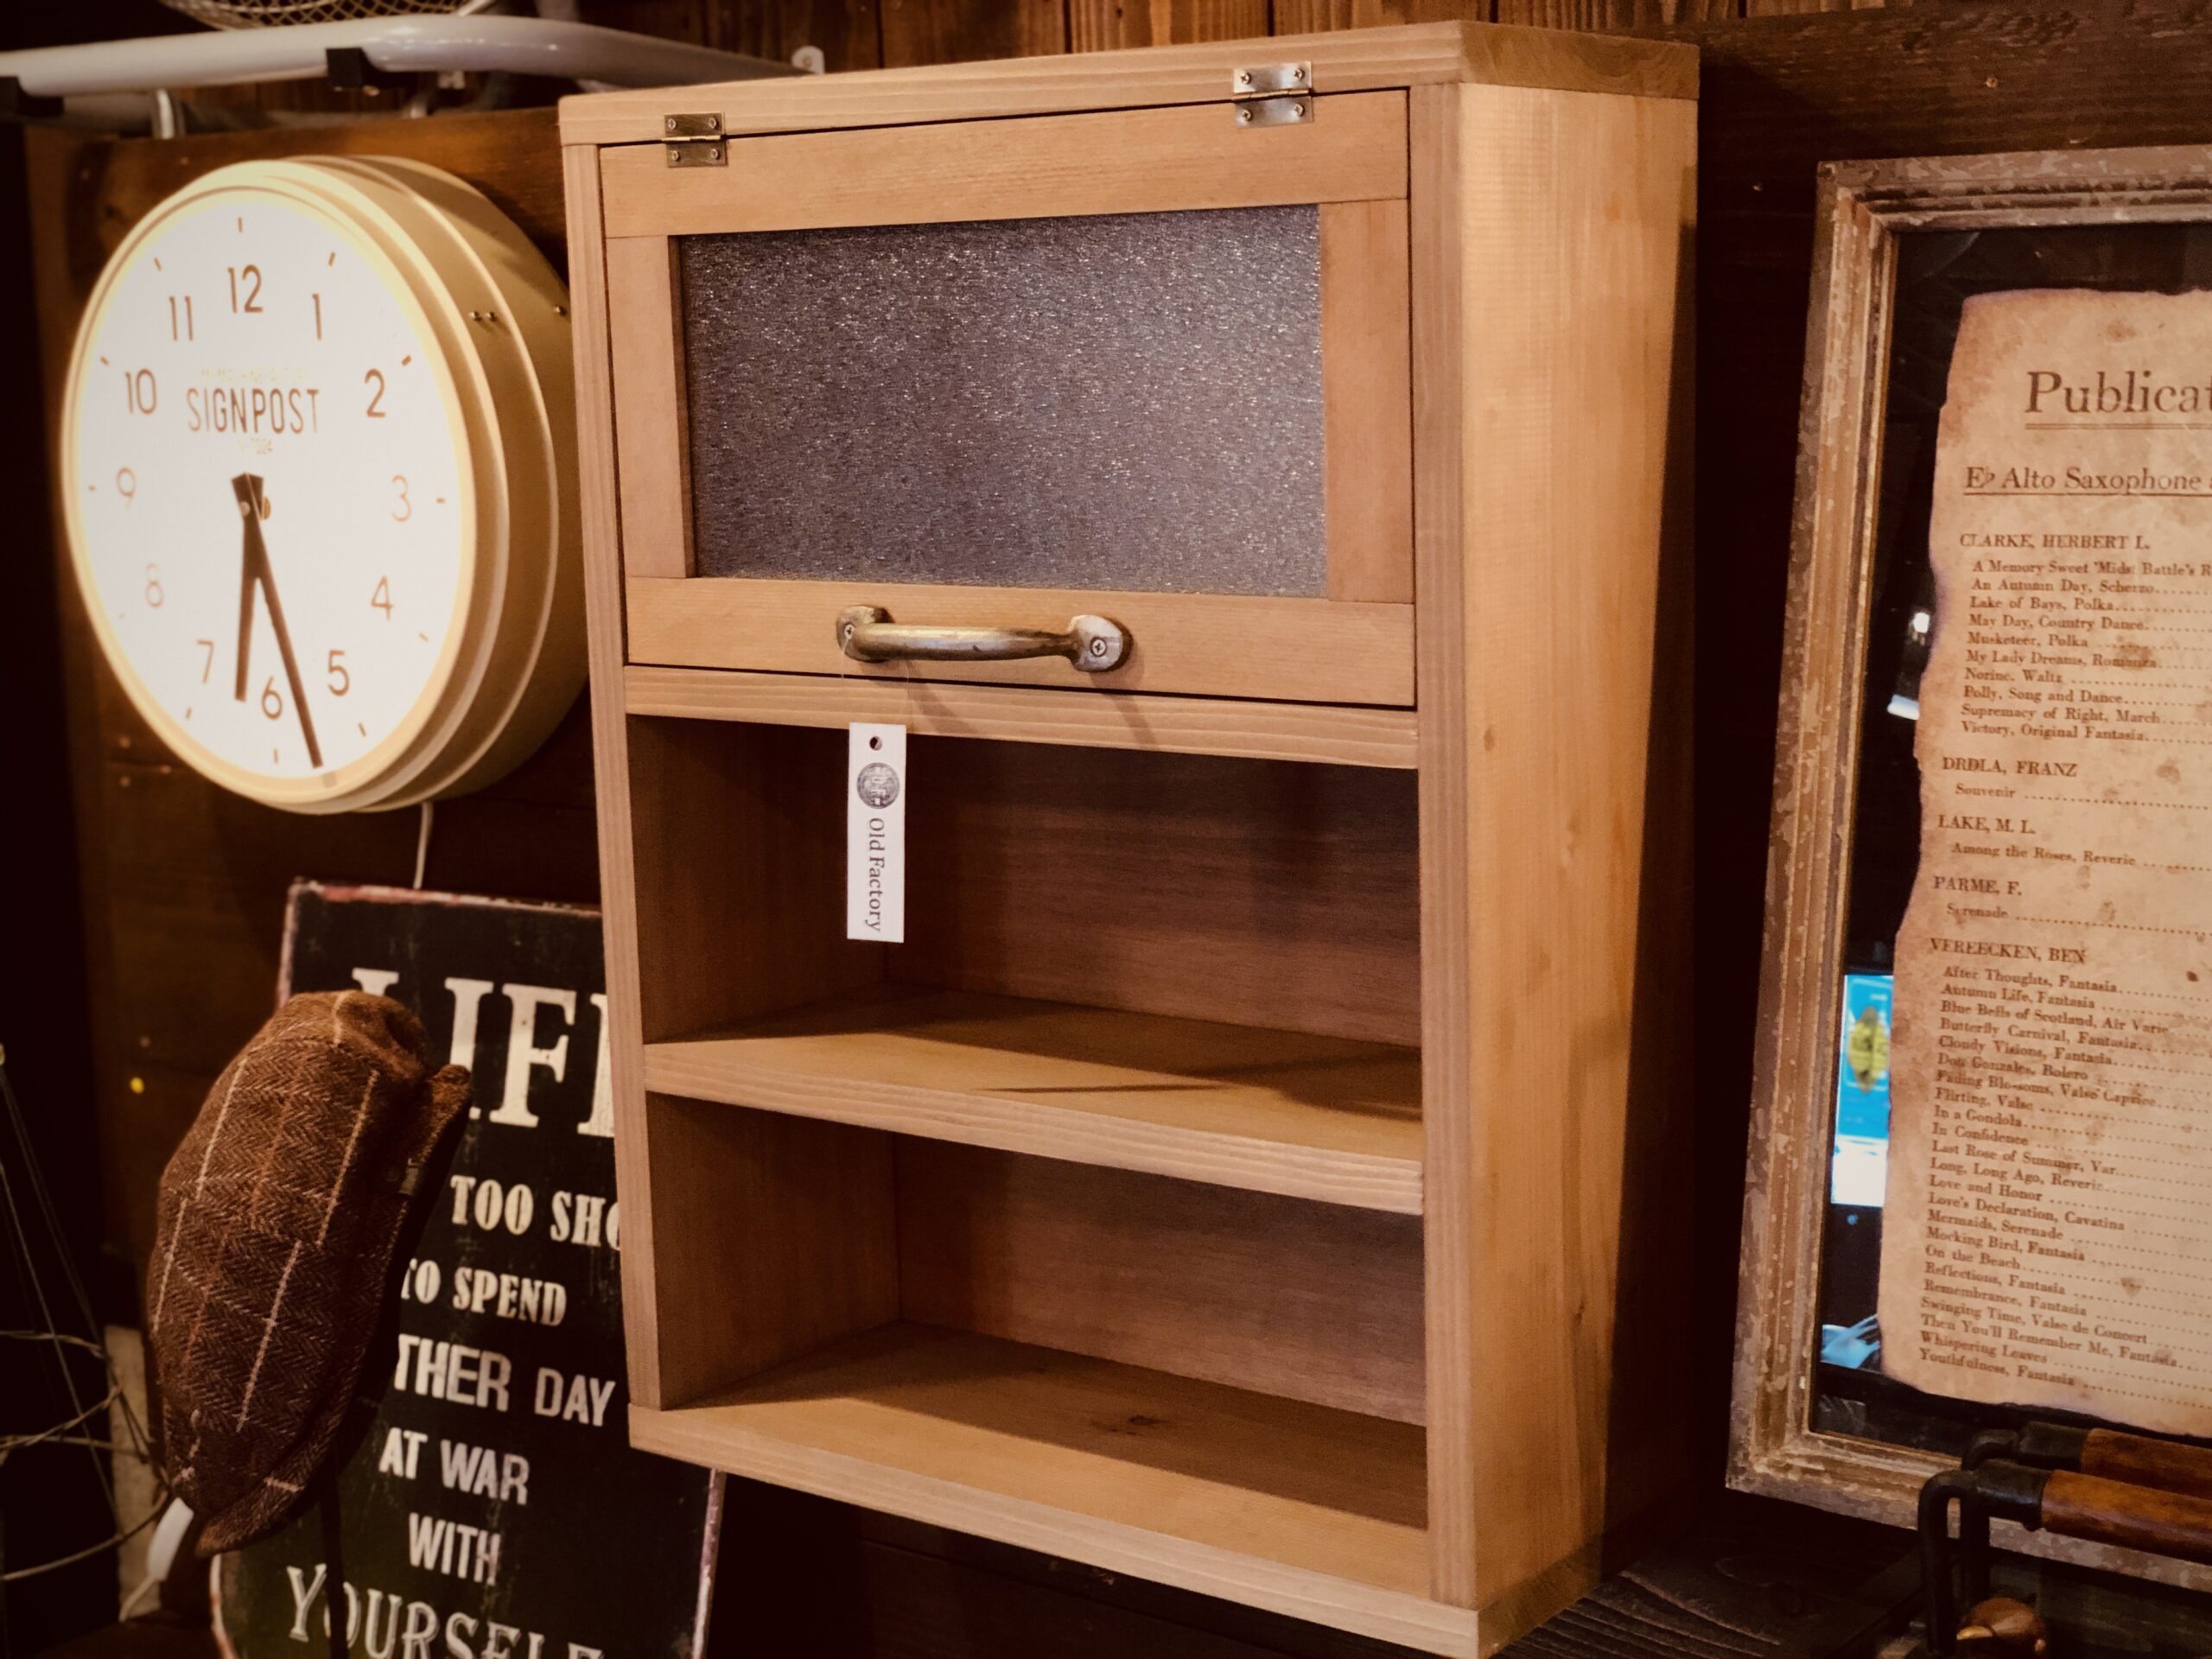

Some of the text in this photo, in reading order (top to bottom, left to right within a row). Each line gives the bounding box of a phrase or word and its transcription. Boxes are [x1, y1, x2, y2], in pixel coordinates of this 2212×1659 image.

[228, 264, 264, 313] 12
[169, 296, 194, 340] 11
[312, 294, 321, 339] 1
[125, 370, 157, 414] 10
[365, 370, 386, 416] 2
[187, 388, 319, 434] SIGNPOST
[117, 467, 137, 510] 9
[2002, 466, 2055, 489] Alto
[2065, 467, 2201, 493] Saxophone
[391, 475, 411, 521] 3
[2042, 534, 2129, 549] HERBERT
[2136, 535, 2150, 550] L.
[1973, 560, 2195, 576] A Memory Sweet Battle's
[146, 563, 163, 607] 8
[371, 575, 393, 620] 4
[1972, 579, 1990, 590] An
[1999, 580, 2053, 591] Autumn
[1971, 596, 2002, 608] Lake
[2009, 597, 2024, 608] of
[2075, 598, 2113, 611] Polka
[1969, 613, 1996, 629] May
[2039, 616, 2094, 631] Country
[2101, 617, 2144, 630] Dance
[2050, 633, 2088, 647] Polka
[197, 640, 214, 683] 7
[1967, 650, 1986, 664] My
[1993, 650, 2024, 665] Lady
[327, 650, 350, 696] 5
[2023, 669, 2062, 683] Waltz
[261, 676, 282, 719] 6
[2009, 688, 2042, 703] Song
[2049, 690, 2073, 702] and
[2081, 690, 2122, 703] Dance
[1961, 703, 2035, 720] Supremacy
[2044, 707, 2057, 720] of
[2117, 709, 2159, 723] March
[2022, 721, 2076, 739] Original
[2085, 726, 2143, 741] Fantasia
[2017, 760, 2076, 777] FRANZ
[1955, 784, 2015, 798] Souvenir
[869, 817, 885, 850] Old
[2022, 820, 2036, 835] L.
[1952, 842, 1999, 857] Among
[2005, 845, 2027, 857] the
[2083, 850, 2136, 865] Reverie
[865, 856, 885, 931] Factory
[2008, 880, 2022, 895] F.
[2050, 946, 2087, 963] BEN
[1943, 966, 1979, 980] After
[2060, 974, 2117, 992] Fantasia
[1942, 983, 1996, 999] Autumn
[2037, 990, 2094, 1008] Fantasia
[2016, 1007, 2029, 1020] of
[2102, 1016, 2126, 1030] Air
[1940, 1017, 1998, 1036] Butterfly
[2077, 1031, 2139, 1050] Fantasia
[1939, 1035, 1986, 1052] Cloudy
[2055, 1046, 2112, 1065] Fantasia
[2043, 1063, 2088, 1079] Bolero
[1932, 1122, 1947, 1135] In
[1935, 1105, 1948, 1118] In
[1967, 1109, 2022, 1127] Gondola
[1932, 1140, 1959, 1155] Last
[1965, 1143, 1998, 1160] Rose
[2003, 1149, 2018, 1161] of
[1929, 1174, 2043, 1201] Love and Honor
[1974, 1163, 2007, 1180] Long
[2051, 1173, 2105, 1190] Reverie
[450, 1175, 534, 1235] TOO
[1929, 1192, 1969, 1209] Love's
[2064, 1211, 2125, 1230] Cavatina
[1926, 1226, 1983, 1249] Mocking
[2028, 1241, 2085, 1261] Fantasia
[2002, 1220, 2063, 1240] Serenade
[1926, 1243, 1945, 1257] On
[1953, 1249, 1974, 1262] the
[453, 1267, 567, 1326] SPEND
[2009, 1274, 2065, 1294] Fantasia
[2030, 1296, 2087, 1315] Fantasia
[1921, 1297, 1981, 1319] Swinging
[2073, 1320, 2089, 1334] de
[2094, 1325, 2147, 1344] Concert
[1921, 1330, 1997, 1357] Whispering
[1922, 1313, 1955, 1331] Then
[2008, 1327, 2082, 1351] Remember
[2120, 1345, 2177, 1367] Fantasia
[2017, 1365, 2074, 1386] Fantasia
[535, 1367, 616, 1427] DAY
[378, 1427, 530, 1504] AT WAR
[408, 1512, 501, 1586] WITH
